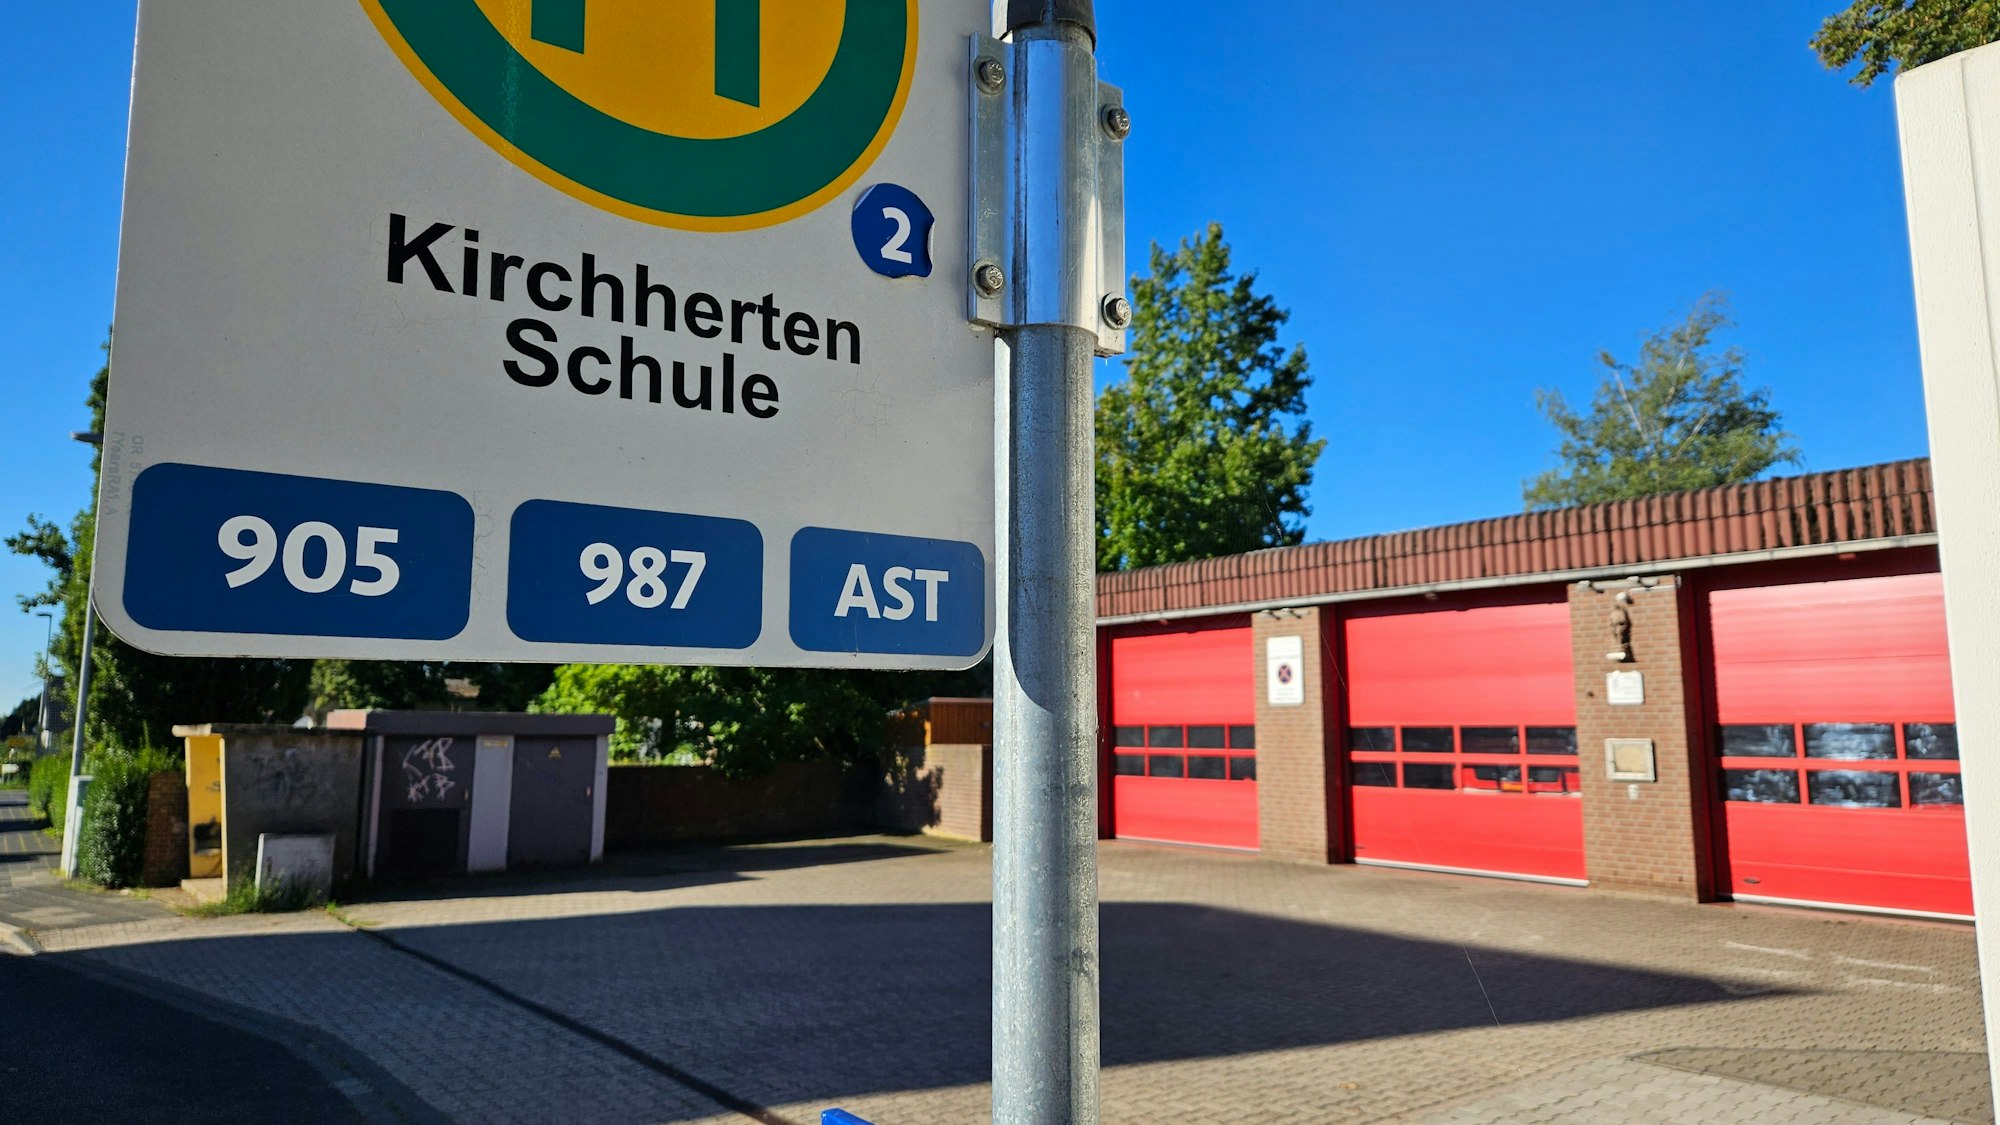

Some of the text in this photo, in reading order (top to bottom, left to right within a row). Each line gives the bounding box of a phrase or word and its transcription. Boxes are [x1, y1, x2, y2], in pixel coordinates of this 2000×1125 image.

[880, 206, 912, 264] 2
[387, 212, 861, 365] Kirchherten
[502, 317, 780, 419] Schule
[217, 515, 400, 597] 905
[579, 542, 707, 610] 987
[833, 563, 949, 622] AST
